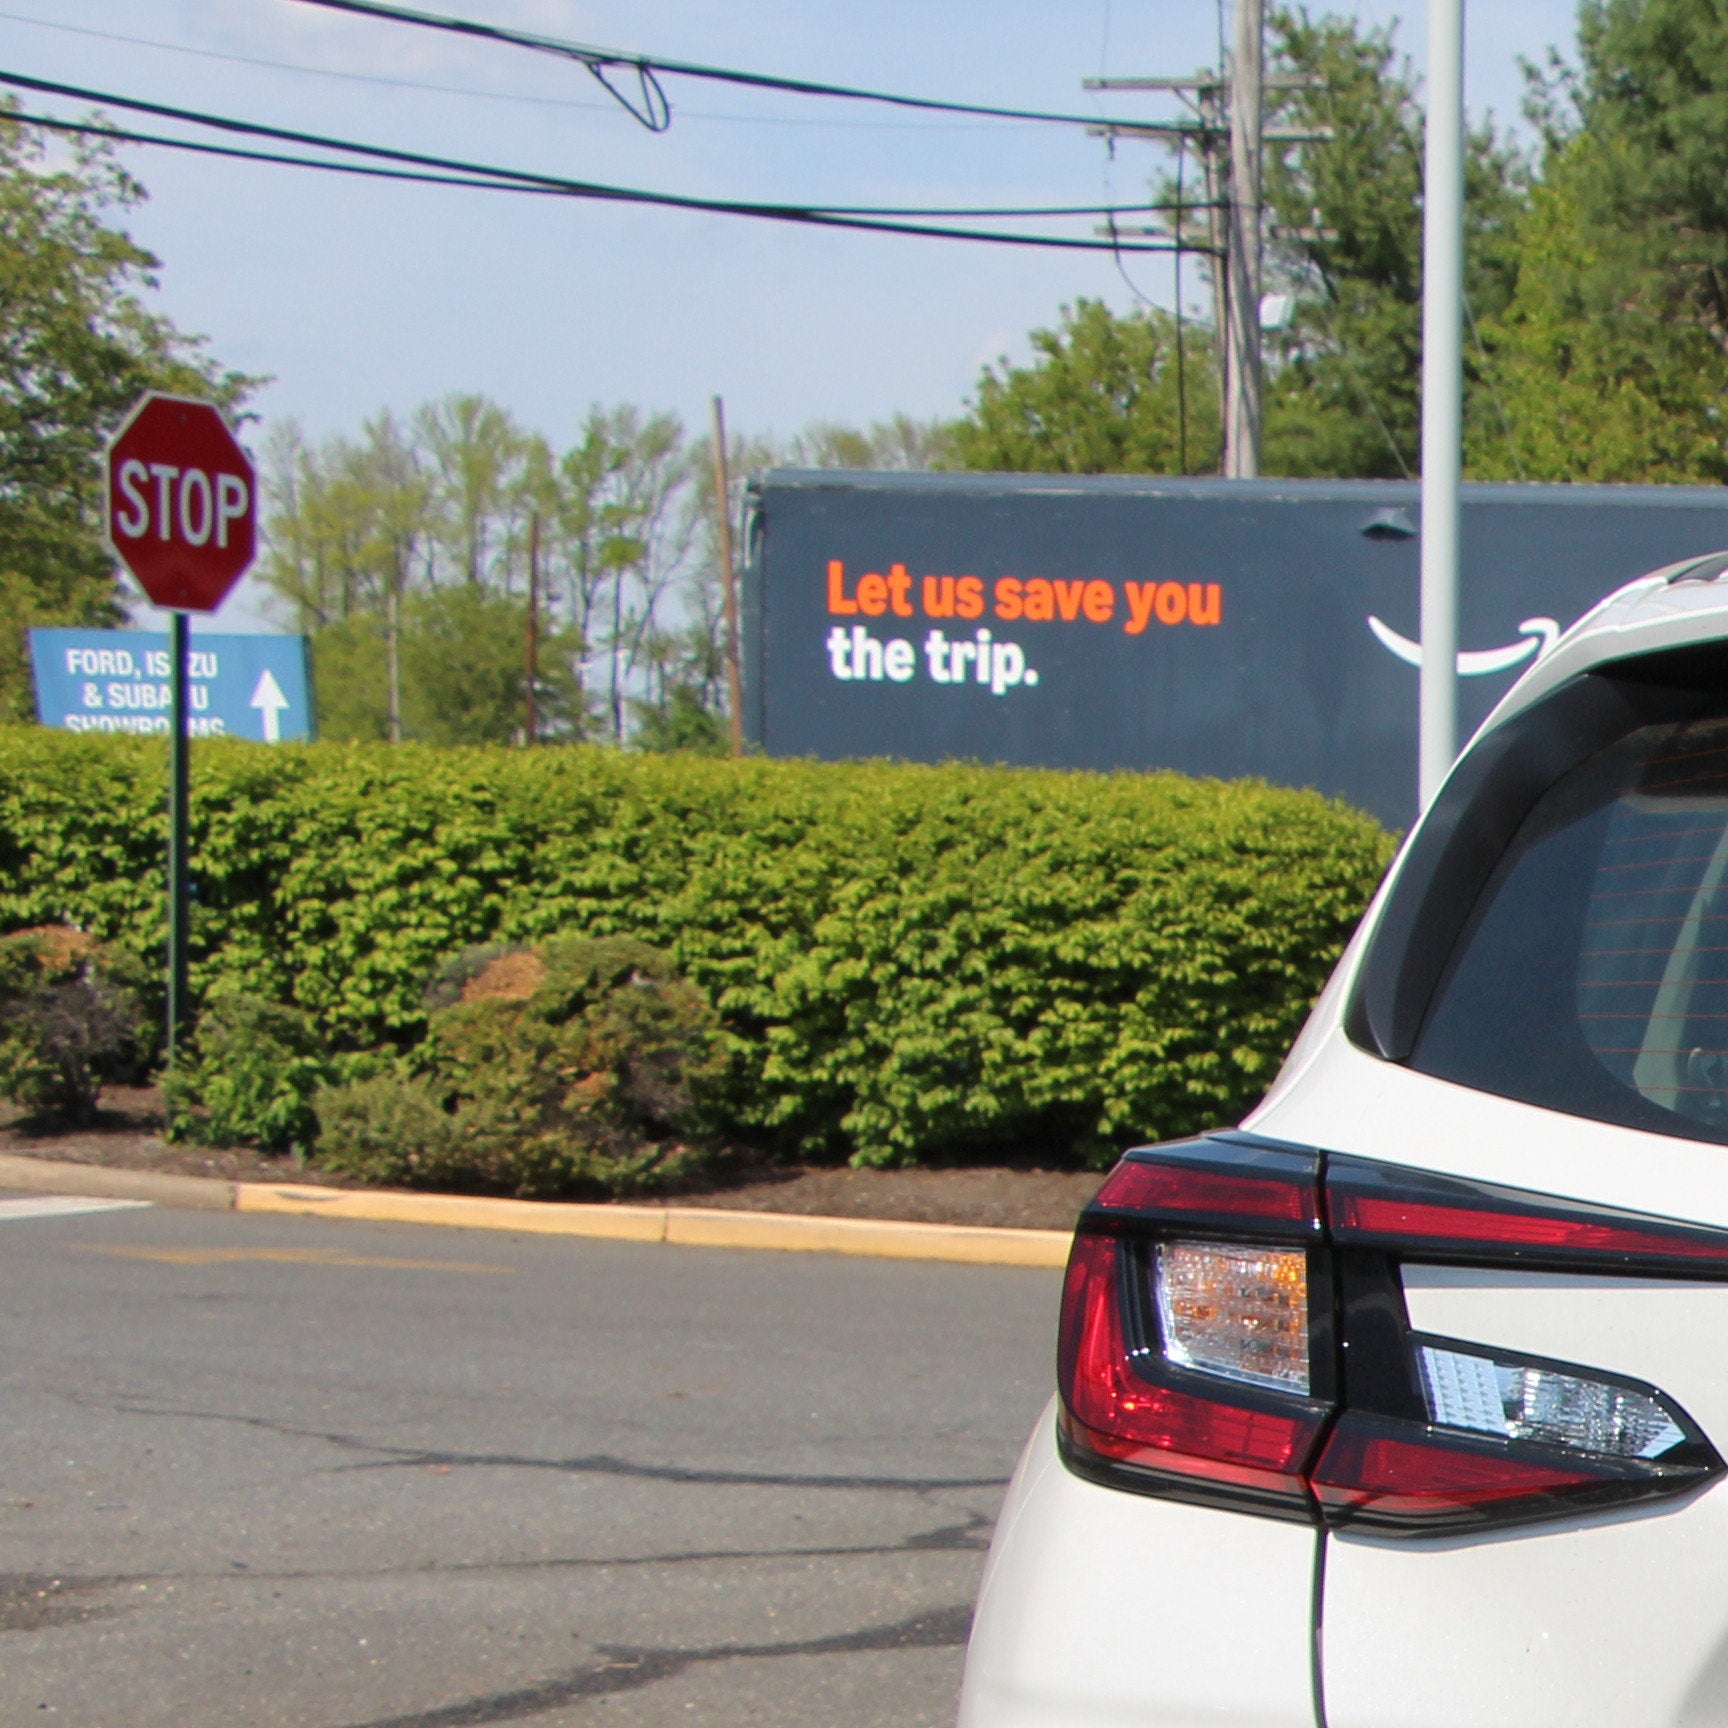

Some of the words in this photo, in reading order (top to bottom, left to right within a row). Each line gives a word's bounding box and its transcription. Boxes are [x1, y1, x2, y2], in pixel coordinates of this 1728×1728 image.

[117, 459, 248, 549] STOP
[827, 559, 913, 617] Let
[922, 574, 985, 620] us
[994, 576, 1115, 623] save
[1123, 579, 1222, 636] you
[66, 648, 142, 680] FORD,
[145, 650, 218, 678] ISZU
[827, 625, 916, 681] the
[924, 628, 1039, 695] trip.
[83, 682, 103, 708] &
[107, 682, 209, 709] SUBAU
